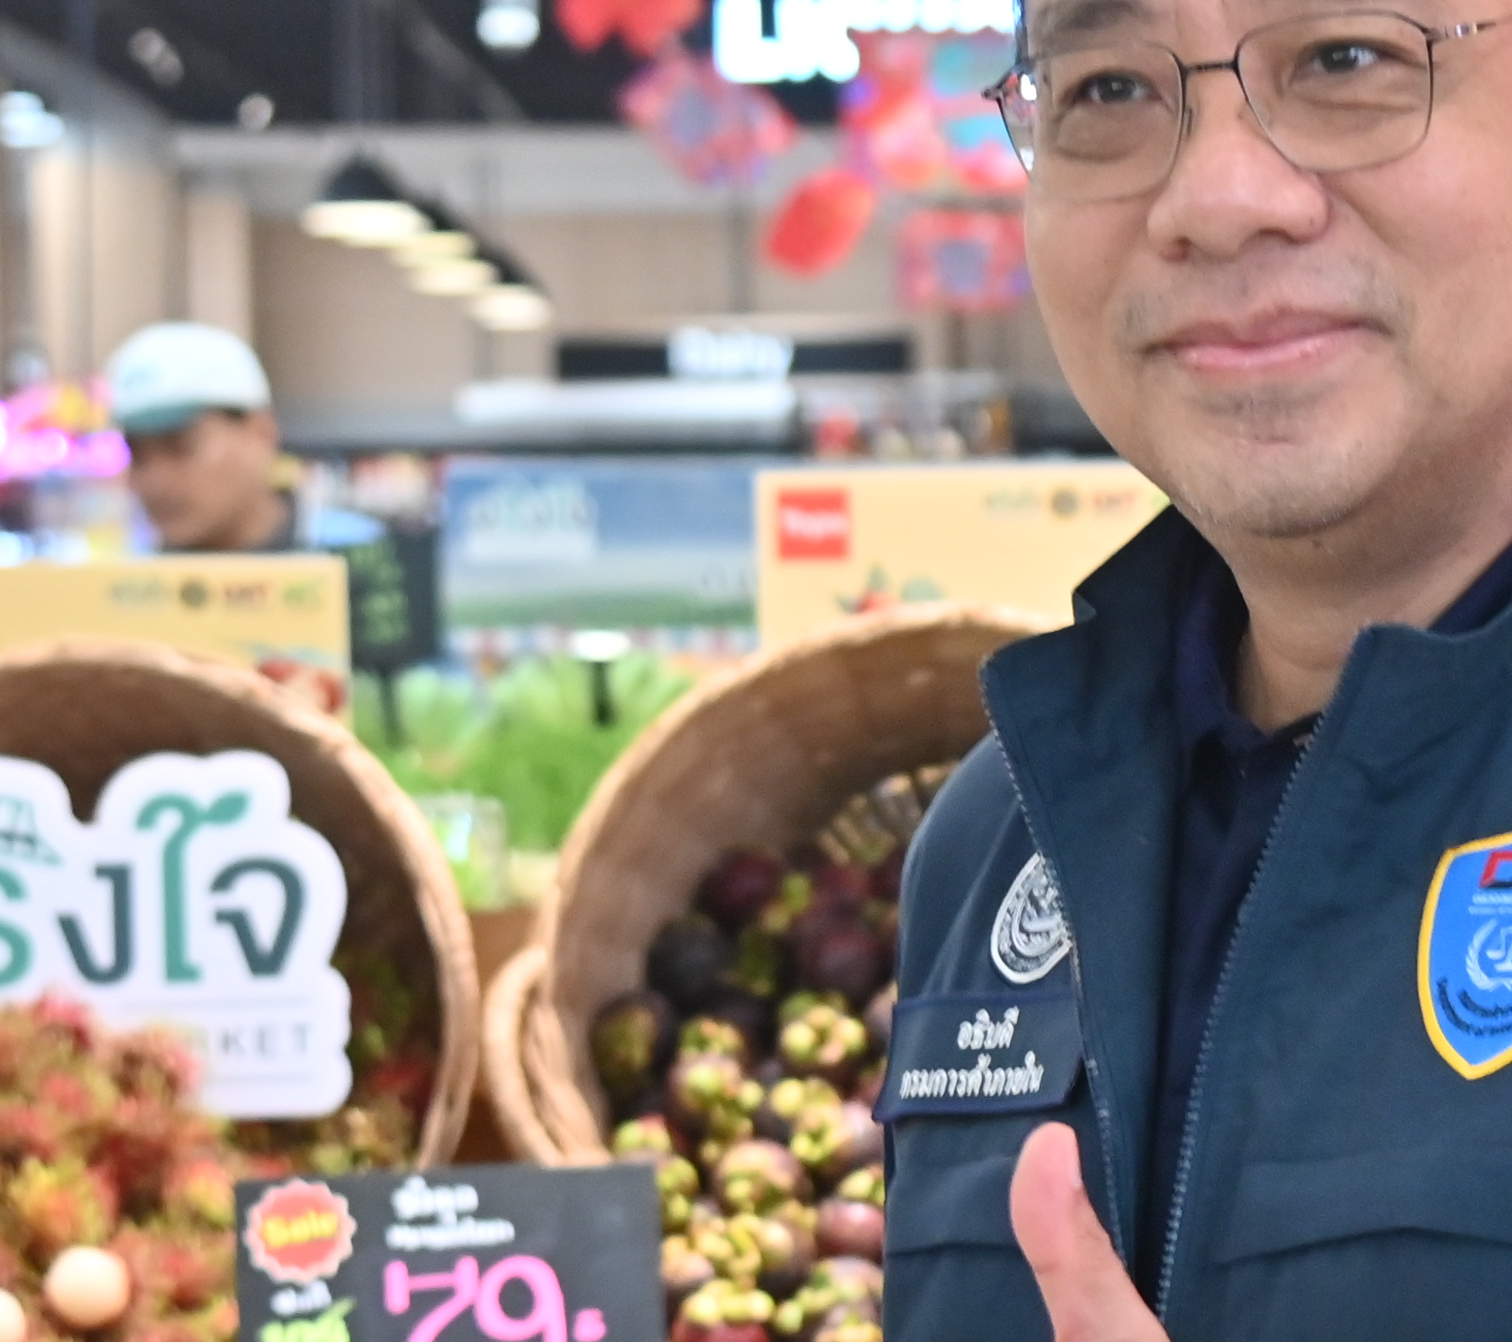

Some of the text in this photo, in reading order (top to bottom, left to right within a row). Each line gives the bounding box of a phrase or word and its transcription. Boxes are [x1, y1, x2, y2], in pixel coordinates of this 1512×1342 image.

[956, 1005, 1020, 1050] อธิบดี
[899, 1050, 1045, 1100] กรมการค้าภายใน
[262, 1211, 339, 1248] Sale
